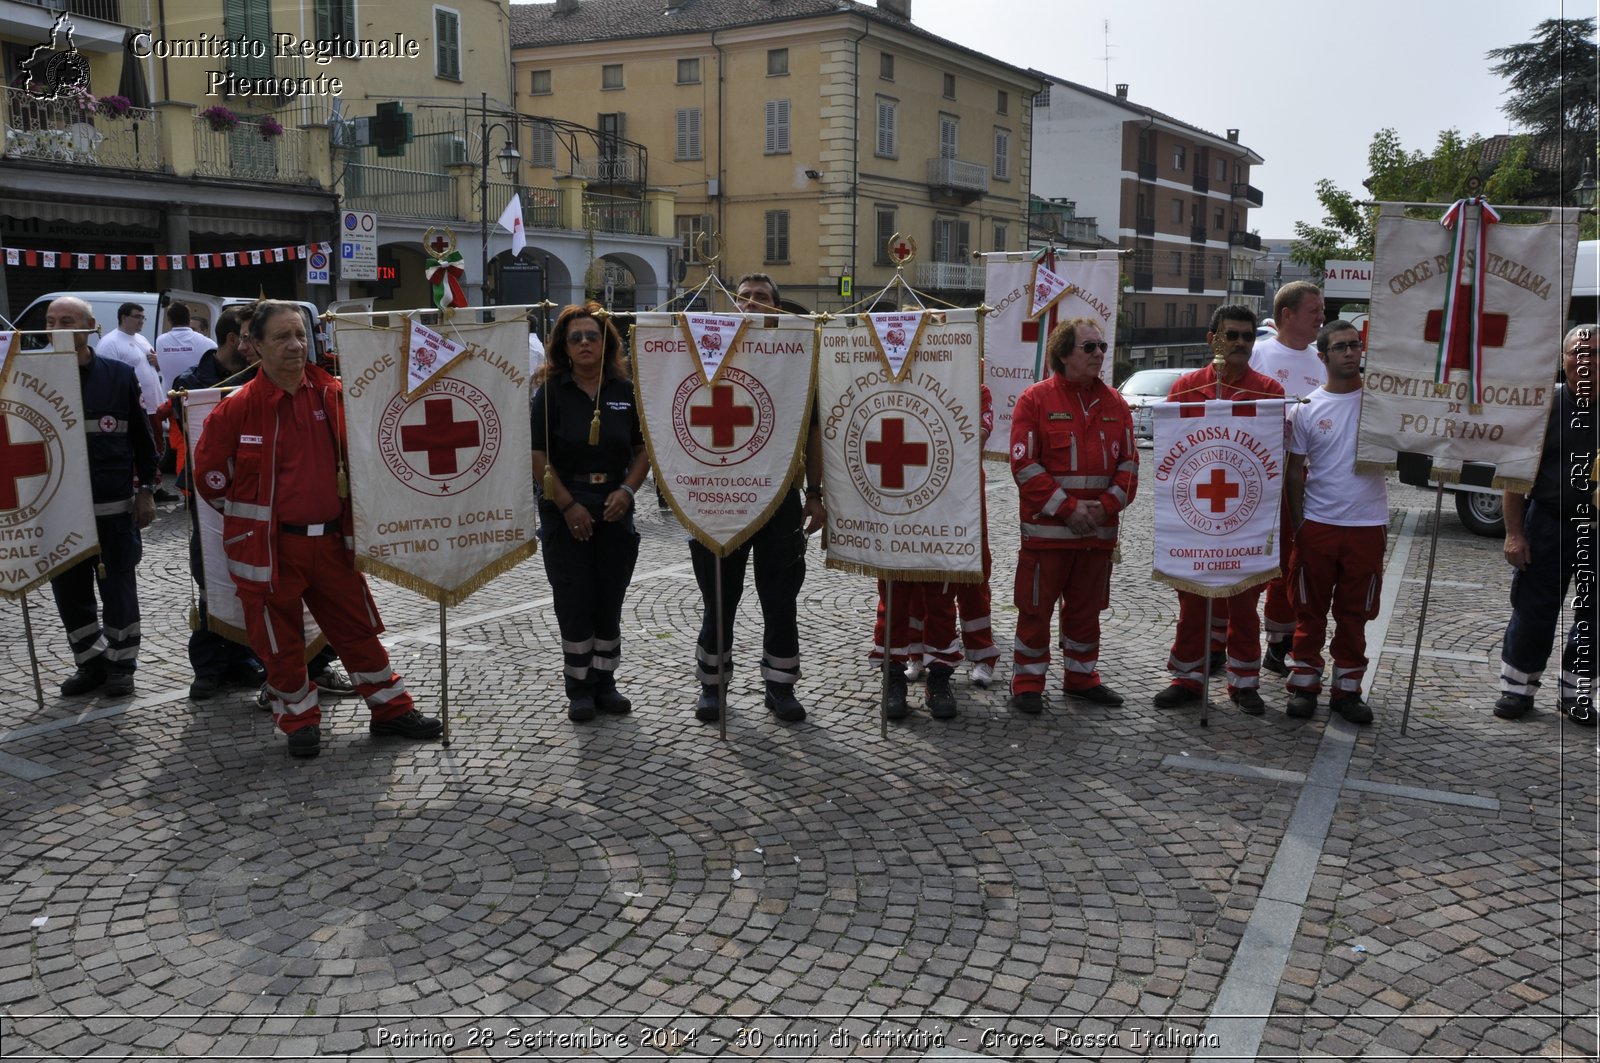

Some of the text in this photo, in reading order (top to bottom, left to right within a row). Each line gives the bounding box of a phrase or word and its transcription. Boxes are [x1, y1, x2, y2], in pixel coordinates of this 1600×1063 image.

[344, 245, 352, 257] P
[1388, 260, 1434, 295] CROCE
[1486, 252, 1552, 300] ITALIANA
[990, 289, 1021, 319] CROCE
[644, 340, 686, 353] CROCE
[742, 341, 805, 354] ITALIANA
[914, 350, 953, 363] PIONIERI
[349, 354, 395, 399] CROCE
[746, 380, 760, 392] 22
[13, 371, 77, 430] ITALIANA
[467, 390, 482, 405] 22
[824, 368, 975, 444] CROCE ROSA ITALIANA
[1447, 402, 1462, 413] DI
[1482, 386, 1546, 406] OCALE
[16, 406, 57, 441] GINEVRA
[675, 383, 697, 454] CONVENZIONE
[757, 390, 771, 435] AGOSTO
[480, 404, 498, 451] AGOSTO
[1400, 414, 1504, 441] POIRINO
[381, 402, 413, 481] CONVENZIONE
[747, 434, 766, 453] 1864
[848, 395, 949, 509] CONVENZIONE DI GINEVRA 22 AGOSTO 1864
[1156, 426, 1280, 482] CROCE ROSSA ITALIANA
[473, 454, 492, 476] 1864
[676, 475, 772, 487] COMITATO LOCALE
[1177, 450, 1259, 531] CONVENZIONE DI GINEVRA 22 AGOSTO 1864
[688, 491, 758, 503] PIOSSASCO
[0, 527, 44, 542] ITATO
[377, 509, 513, 536] COMITATO LOCALE
[836, 518, 967, 537] COMITATO LOCALE DI
[35, 532, 83, 575] D'ASTI
[368, 528, 525, 559] SETTIMO TORINESE
[830, 532, 976, 556] BORGO S. DALMAZZO
[1169, 546, 1263, 558] COMITATO LOCALE
[1193, 560, 1241, 571] DI CHIERI
